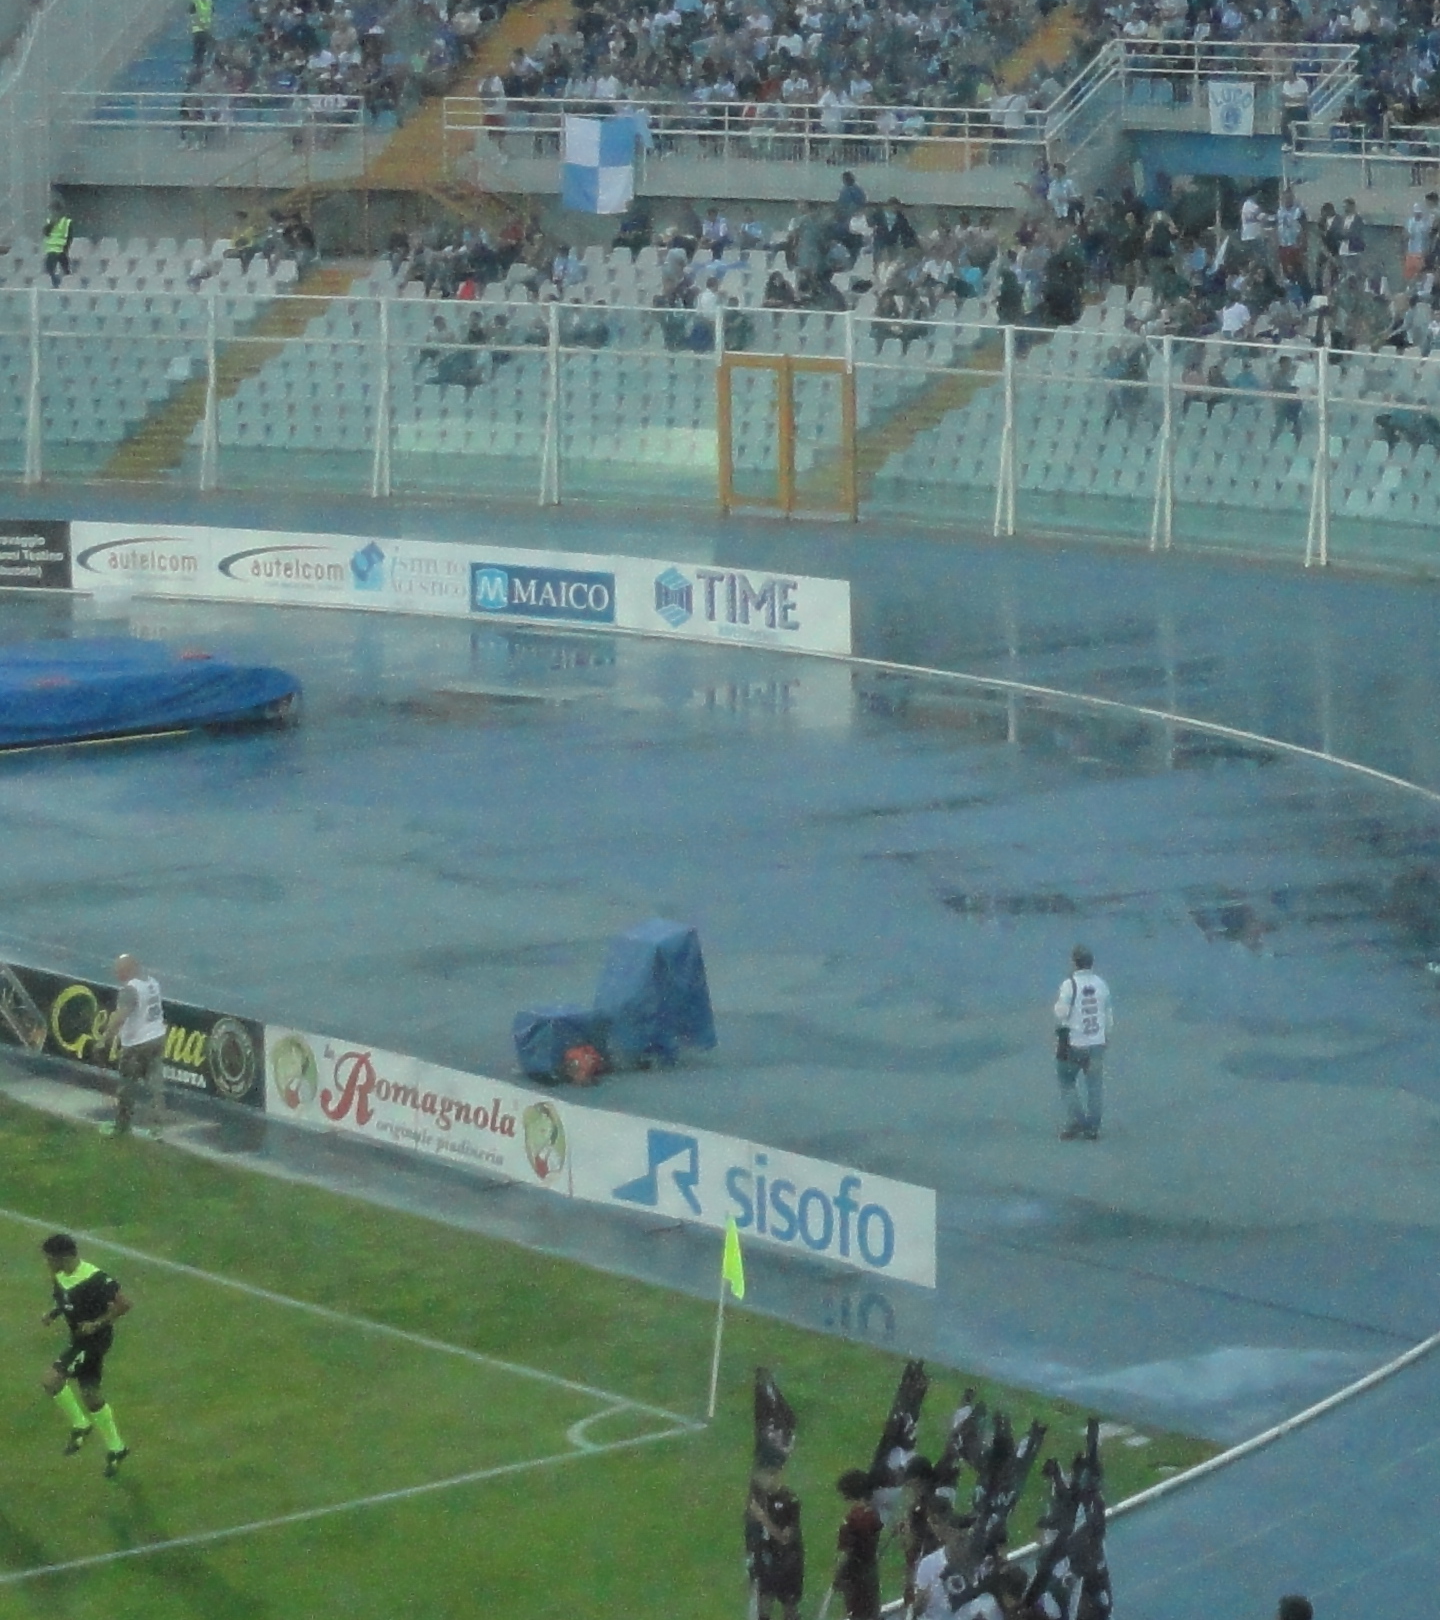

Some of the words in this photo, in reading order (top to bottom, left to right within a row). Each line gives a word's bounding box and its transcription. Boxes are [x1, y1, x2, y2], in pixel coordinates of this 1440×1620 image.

[1210, 88, 1253, 109] LUPO
[108, 550, 198, 572] autelcom
[251, 558, 344, 581] autelcom
[513, 578, 610, 611] MAICO
[696, 569, 800, 630] TIME
[320, 1051, 516, 1138] Romagnola
[725, 1152, 895, 1268] sisofo
